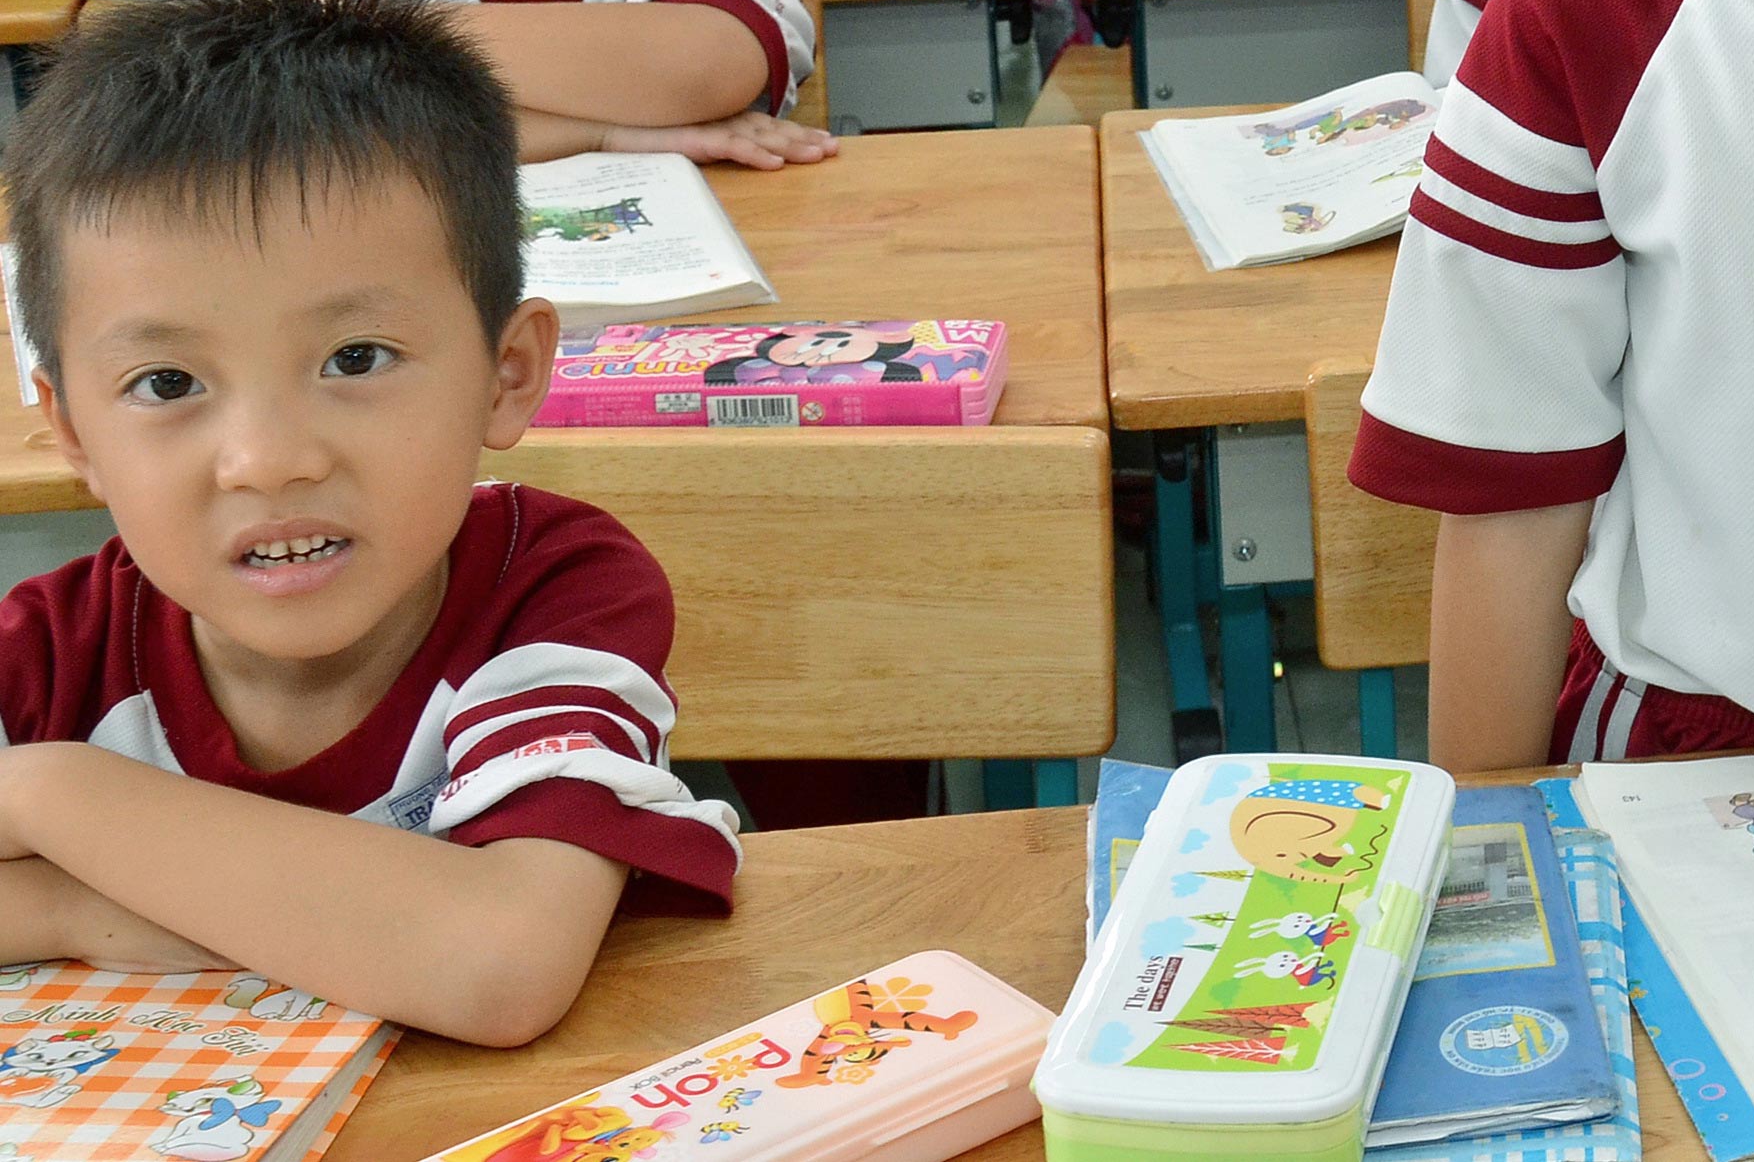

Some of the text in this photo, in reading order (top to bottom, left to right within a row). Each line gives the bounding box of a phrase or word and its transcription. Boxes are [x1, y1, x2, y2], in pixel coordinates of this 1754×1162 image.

[1136, 955, 1165, 984] days
[1123, 986, 1151, 1011] The
[3, 1004, 122, 1025] Minh
[129, 1009, 204, 1034] Học
[661, 1057, 702, 1079] Pencil
